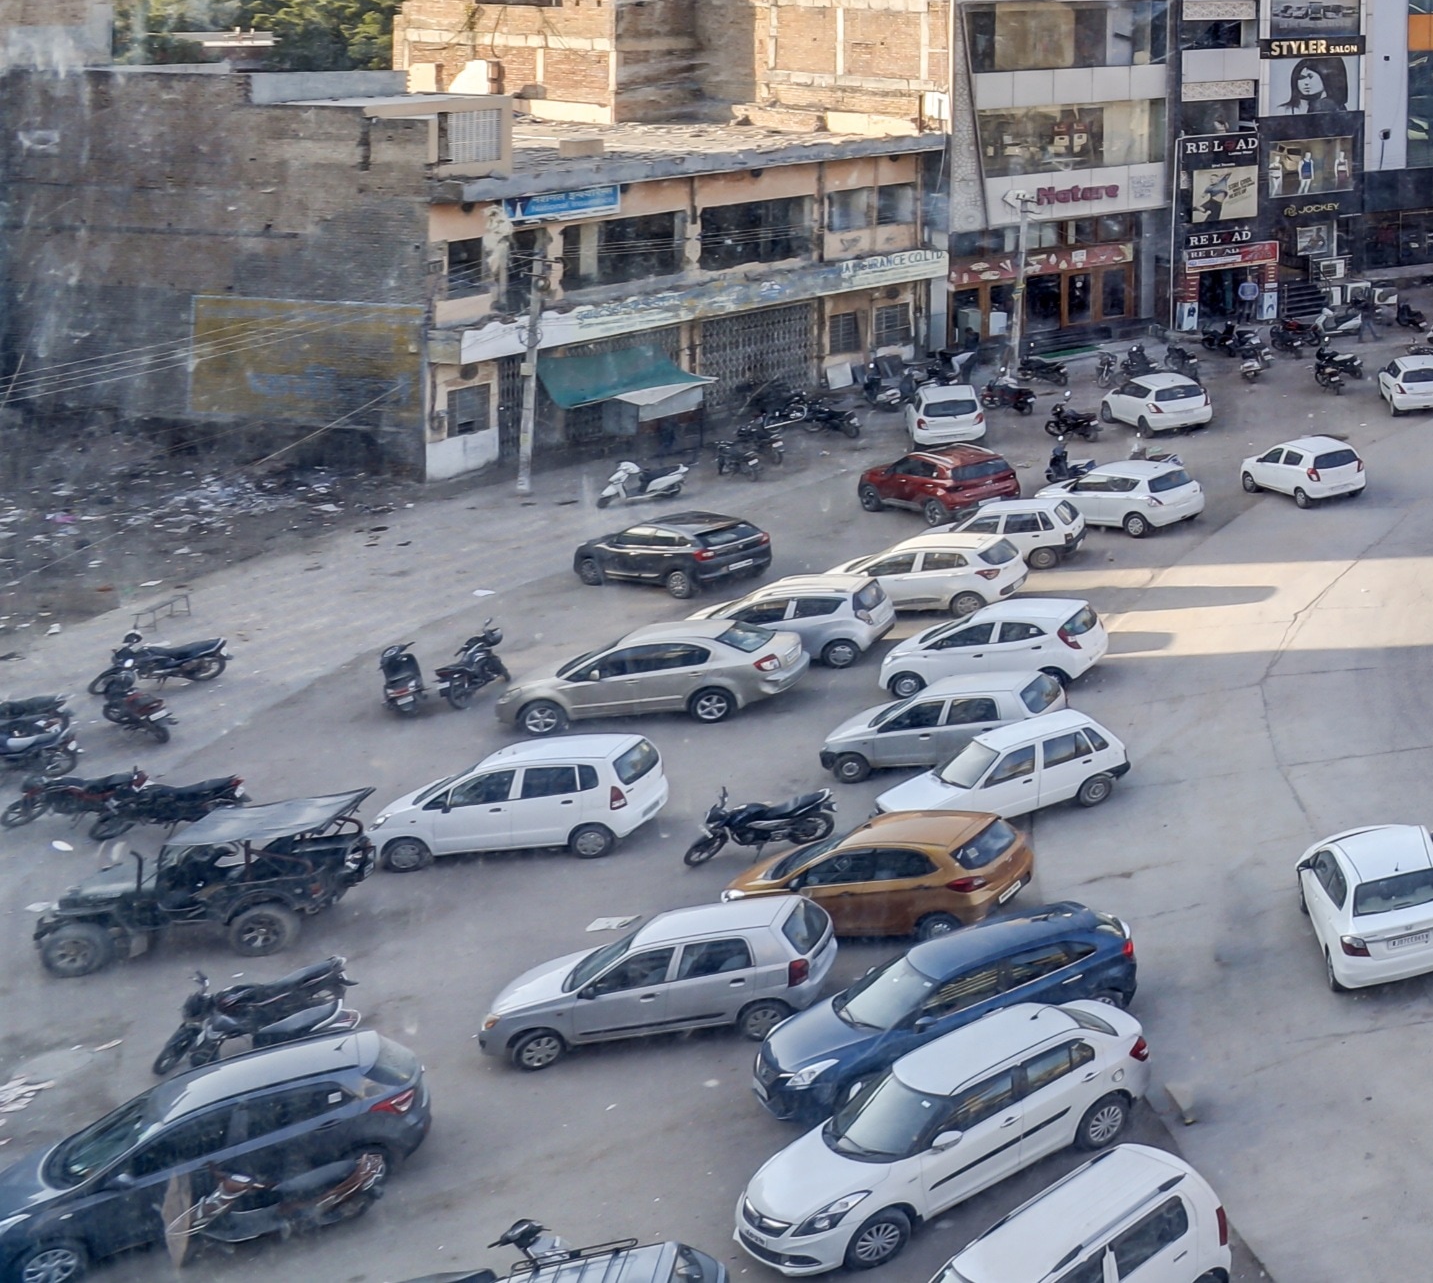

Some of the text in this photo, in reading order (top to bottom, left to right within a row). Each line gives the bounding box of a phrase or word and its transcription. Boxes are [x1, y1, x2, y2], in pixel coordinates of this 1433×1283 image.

[1270, 39, 1358, 56] STYLER SALON
[1298, 202, 1340, 214] JOCKEY
